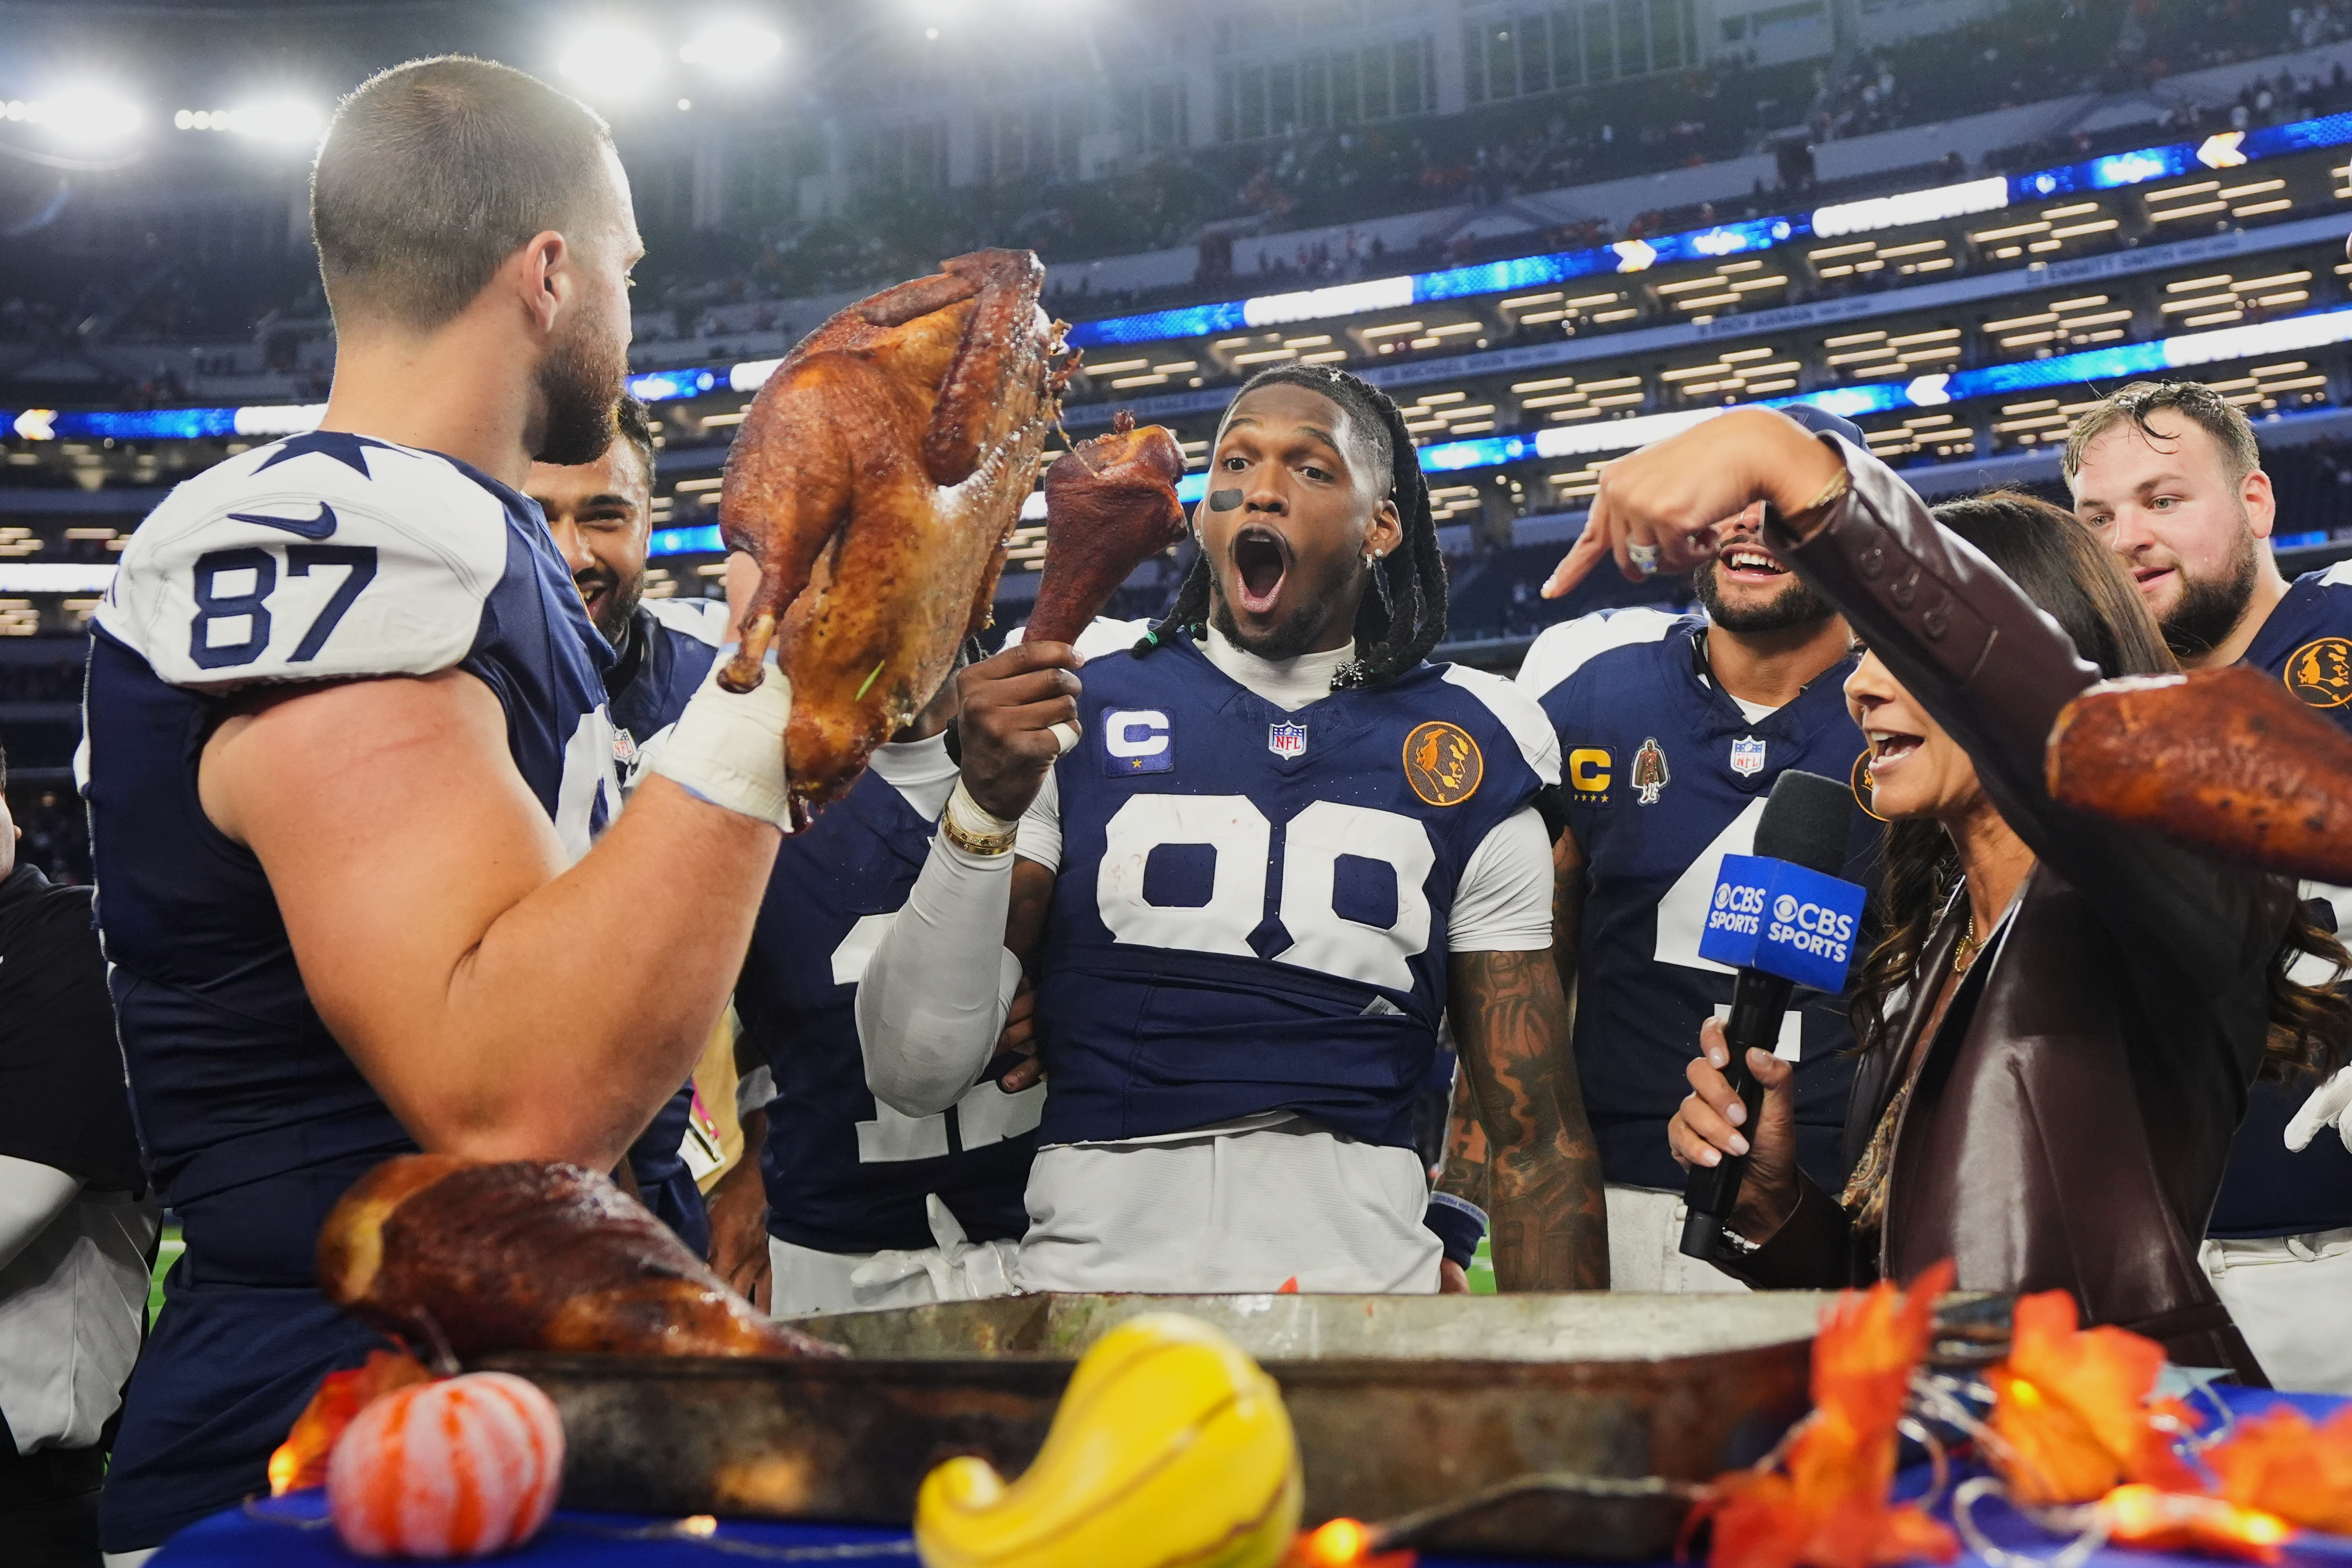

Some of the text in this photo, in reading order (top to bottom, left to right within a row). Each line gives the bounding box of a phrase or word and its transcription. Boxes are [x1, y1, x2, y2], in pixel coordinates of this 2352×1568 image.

[189, 544, 377, 669] 87
[614, 741, 632, 756] NFL
[1106, 710, 1169, 758] C
[1276, 735, 1301, 751] NFL
[1570, 749, 1612, 792] C
[1736, 755, 1759, 769] NFL
[1729, 885, 1766, 915] CBS
[1709, 910, 1760, 935] SPORTS
[1797, 903, 1854, 942] CBS
[1767, 922, 1848, 963] SPORTS
